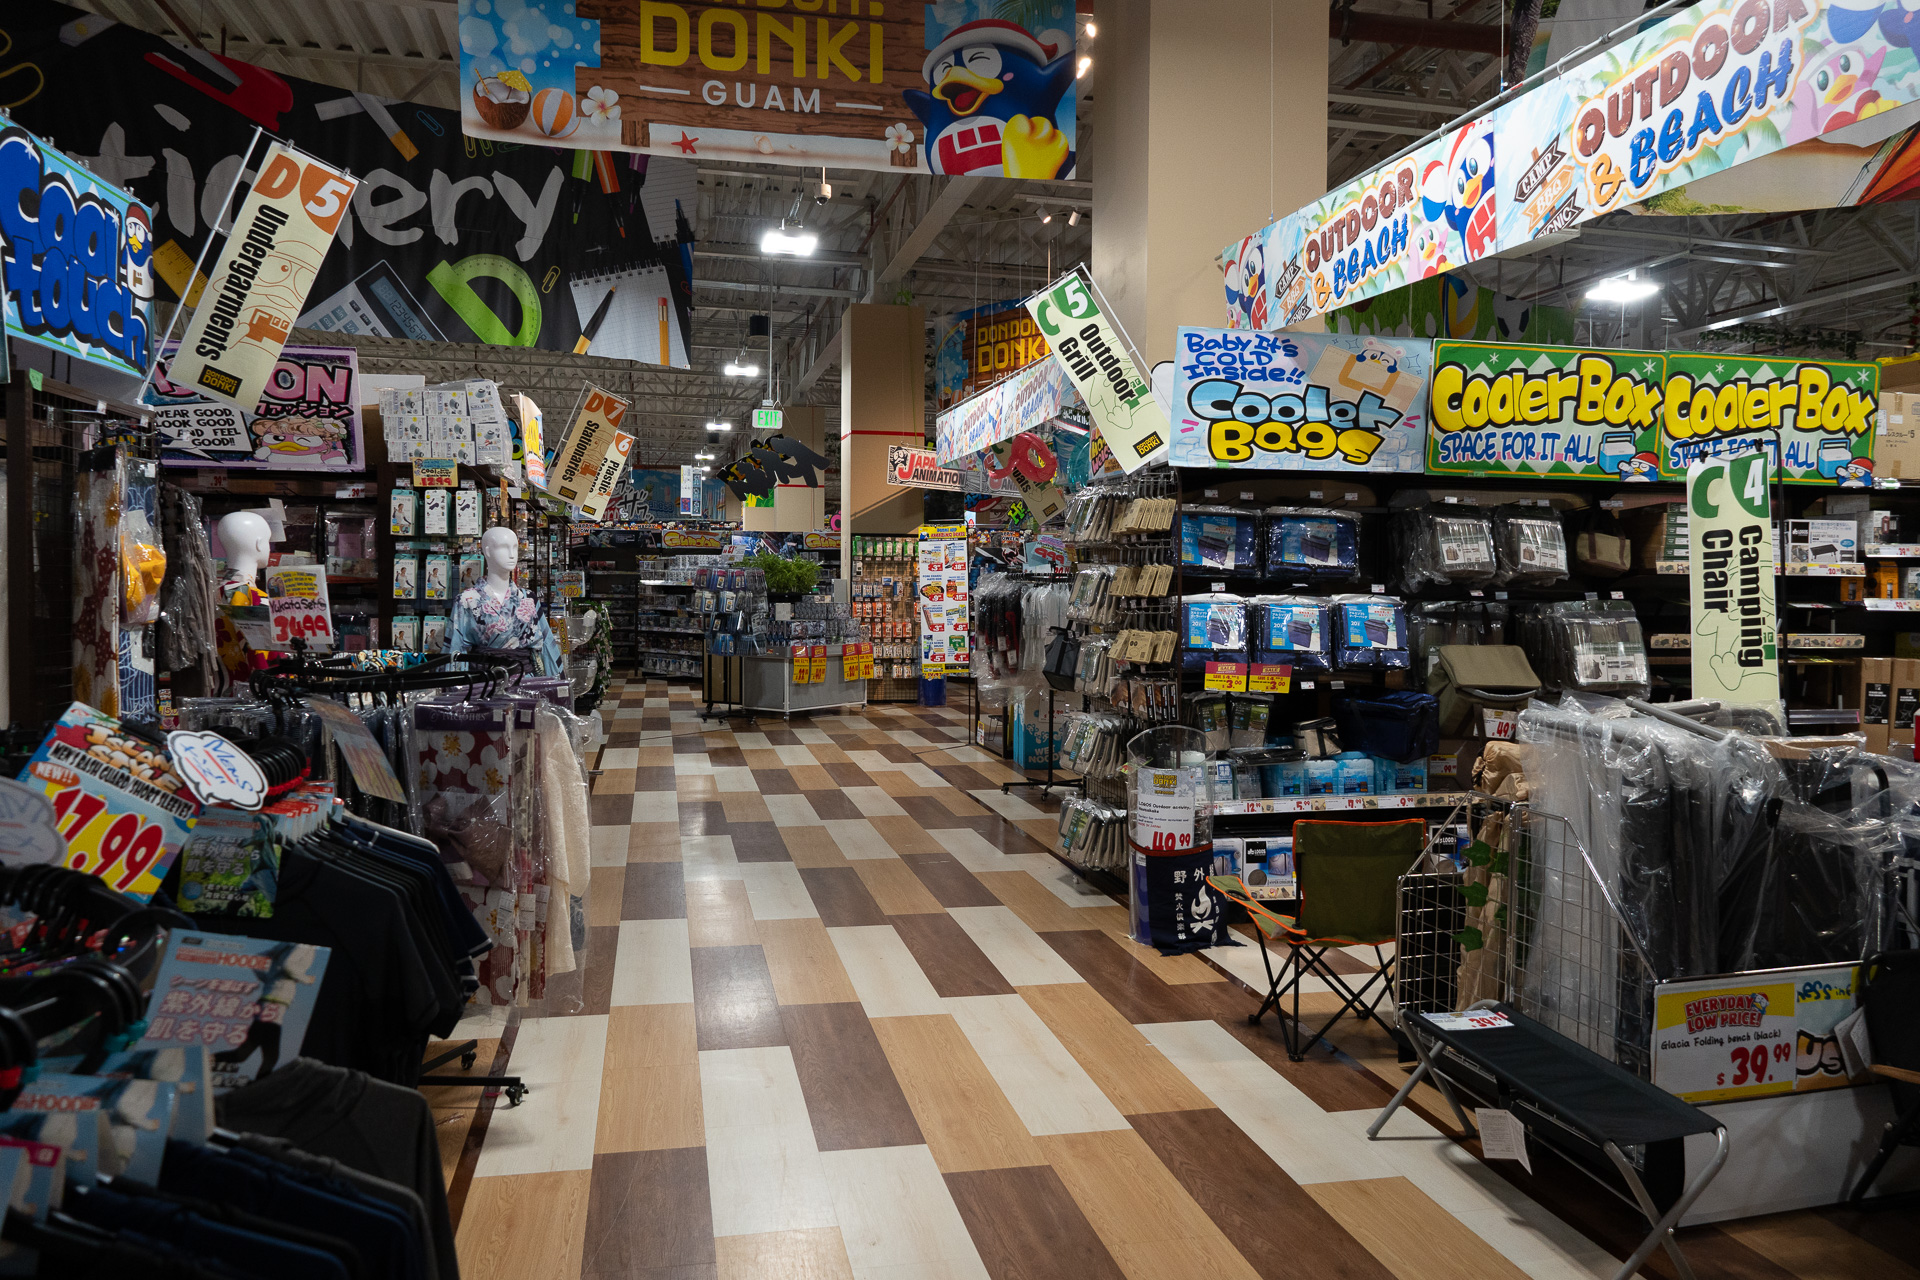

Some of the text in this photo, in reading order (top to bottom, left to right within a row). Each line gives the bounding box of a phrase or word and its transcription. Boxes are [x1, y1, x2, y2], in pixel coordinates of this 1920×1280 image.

[640, 0, 883, 84] DONKI
[702, 80, 820, 114] GUAM
[1590, 37, 1793, 206] & BEACH
[253, 153, 350, 218] D 5
[1521, 153, 1553, 194] CAMP
[1536, 180, 1563, 215] BBQ
[1305, 168, 1417, 272] OUTDOOR
[1313, 213, 1409, 309] & BEACH
[195, 204, 289, 361] Undergarments
[1036, 283, 1088, 336] C 5
[978, 322, 1008, 345] DON
[1183, 332, 1299, 358] Baby It's
[1058, 336, 1098, 382] Grill
[1079, 322, 1135, 403] Outdoor
[1195, 350, 1273, 366] COLD
[202, 374, 236, 394] DONKI
[1182, 364, 1306, 386] Inside!!
[583, 391, 626, 420] D 7
[757, 410, 779, 428] EXIT
[1187, 378, 1404, 432] Cooler
[197, 418, 236, 427] GOOD
[213, 428, 241, 437] FEEL
[192, 437, 236, 447] GOOD!!
[561, 419, 600, 484] Stationaries
[617, 437, 631, 452] 6
[1139, 438, 1161, 454] DONKI
[1207, 417, 1385, 465] Bags
[1439, 431, 1597, 465] SPACE FOR IT ALL
[1784, 440, 1816, 470] ALL
[598, 459, 620, 495] Plastic
[912, 468, 966, 486] ANIMATION
[1691, 458, 1765, 518] C 4
[1702, 529, 1733, 614] Chair
[269, 599, 301, 614] Yukata
[85, 723, 180, 776] ISLAN
[34, 763, 75, 785] NEW!!
[154, 792, 194, 819] SLEEVES
[184, 859, 245, 875] 肌を守る
[159, 991, 284, 1022] 紫外線から
[1685, 994, 1755, 1019] EVERYDAY
[144, 1015, 249, 1045] 肌を守る
[1686, 1009, 1762, 1035] LOW PRICE!
[1660, 1029, 1782, 1050] Glacia Folding bench (black)
